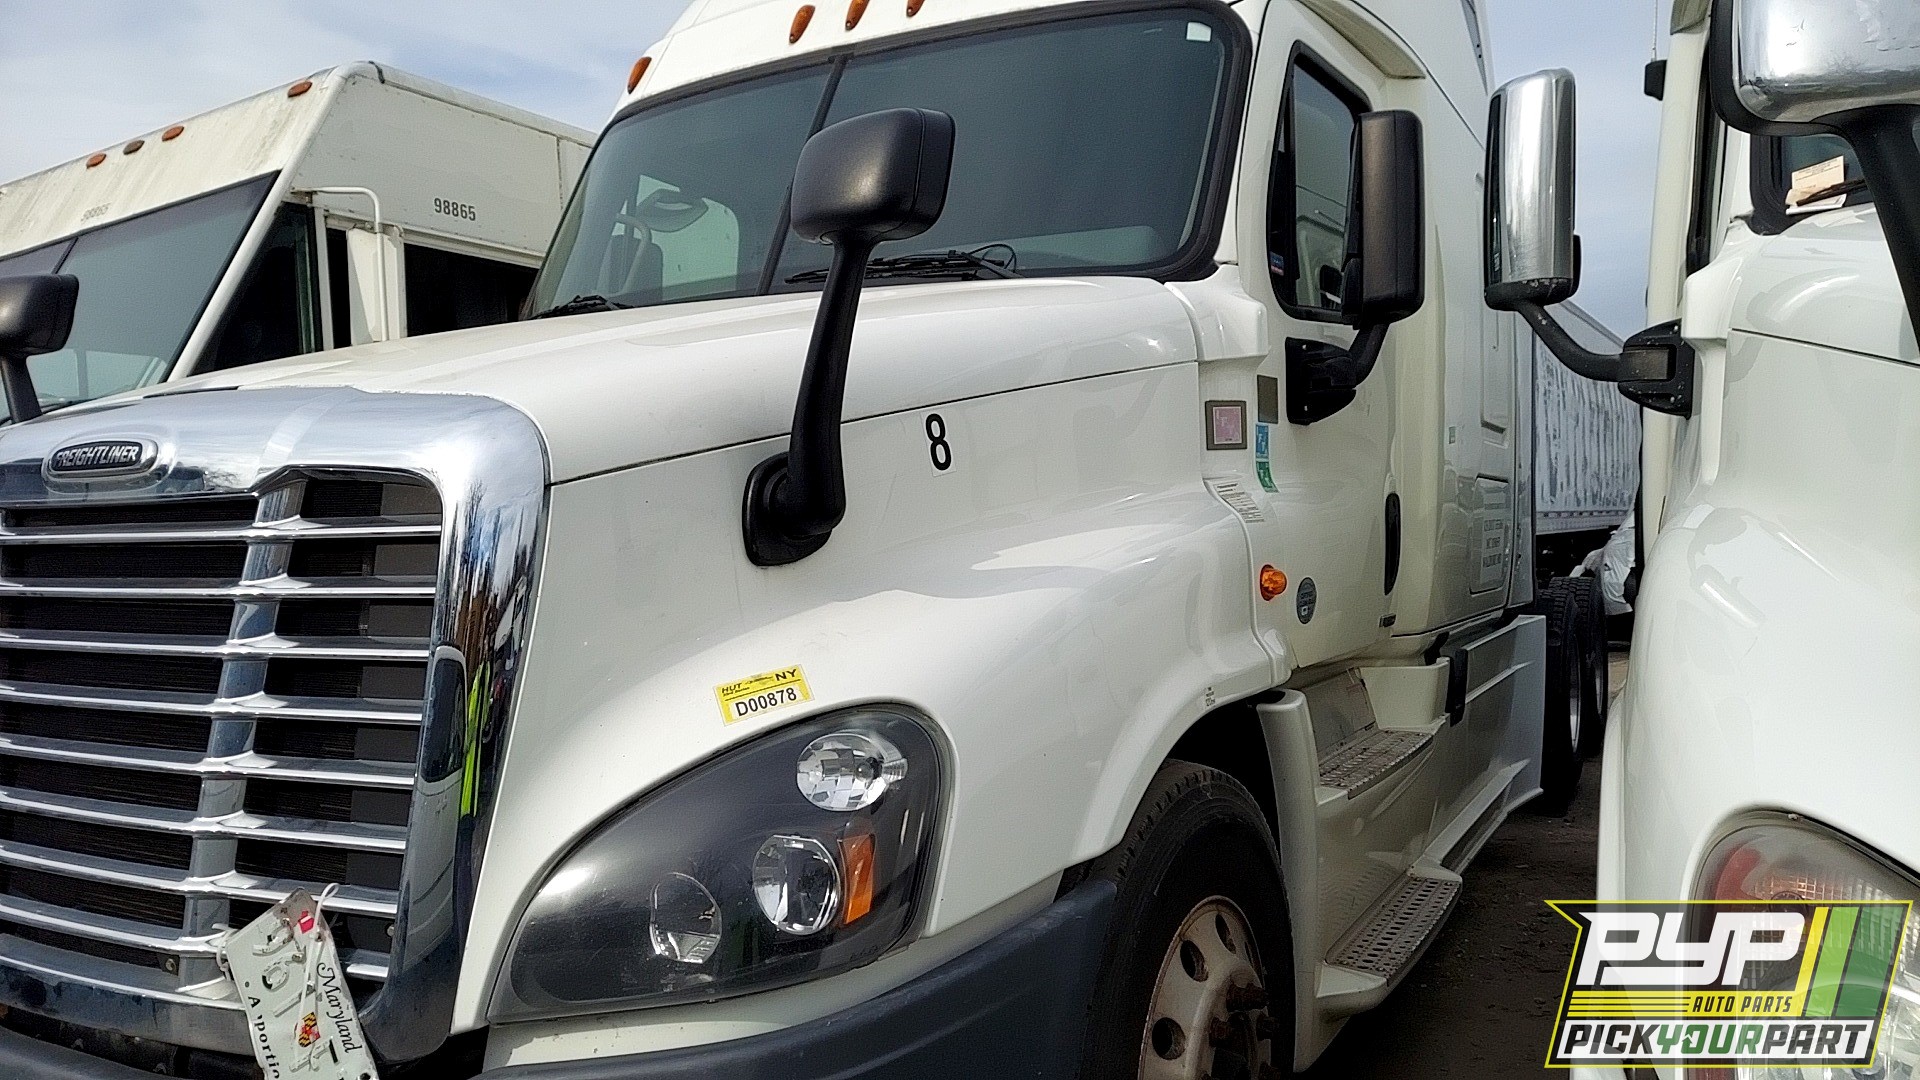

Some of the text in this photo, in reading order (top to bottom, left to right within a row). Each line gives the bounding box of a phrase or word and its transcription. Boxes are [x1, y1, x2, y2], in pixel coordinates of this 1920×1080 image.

[433, 197, 476, 221] 98865
[925, 412, 952, 471] 8
[55, 445, 140, 468] FREIGHTLINER
[721, 682, 743, 694] HUT
[774, 668, 797, 681] NY
[735, 687, 797, 717] D00878
[316, 962, 363, 1054] Maryland
